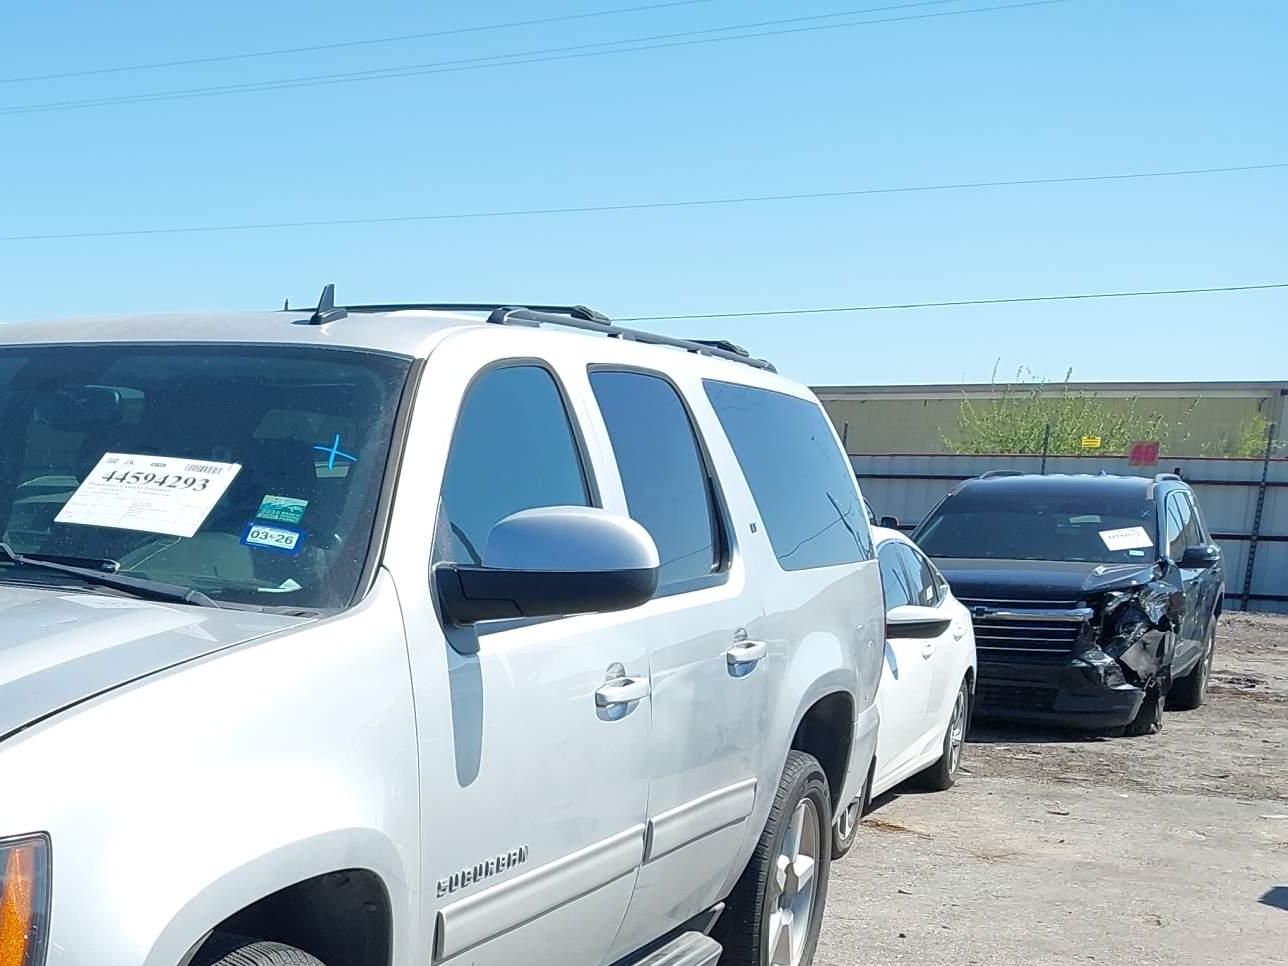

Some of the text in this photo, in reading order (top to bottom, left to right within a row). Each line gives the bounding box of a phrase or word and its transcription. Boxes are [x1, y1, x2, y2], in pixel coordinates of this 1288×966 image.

[101, 469, 210, 492] 44594293
[250, 530, 294, 545] 03 26
[436, 844, 529, 898] SUBURBAN
